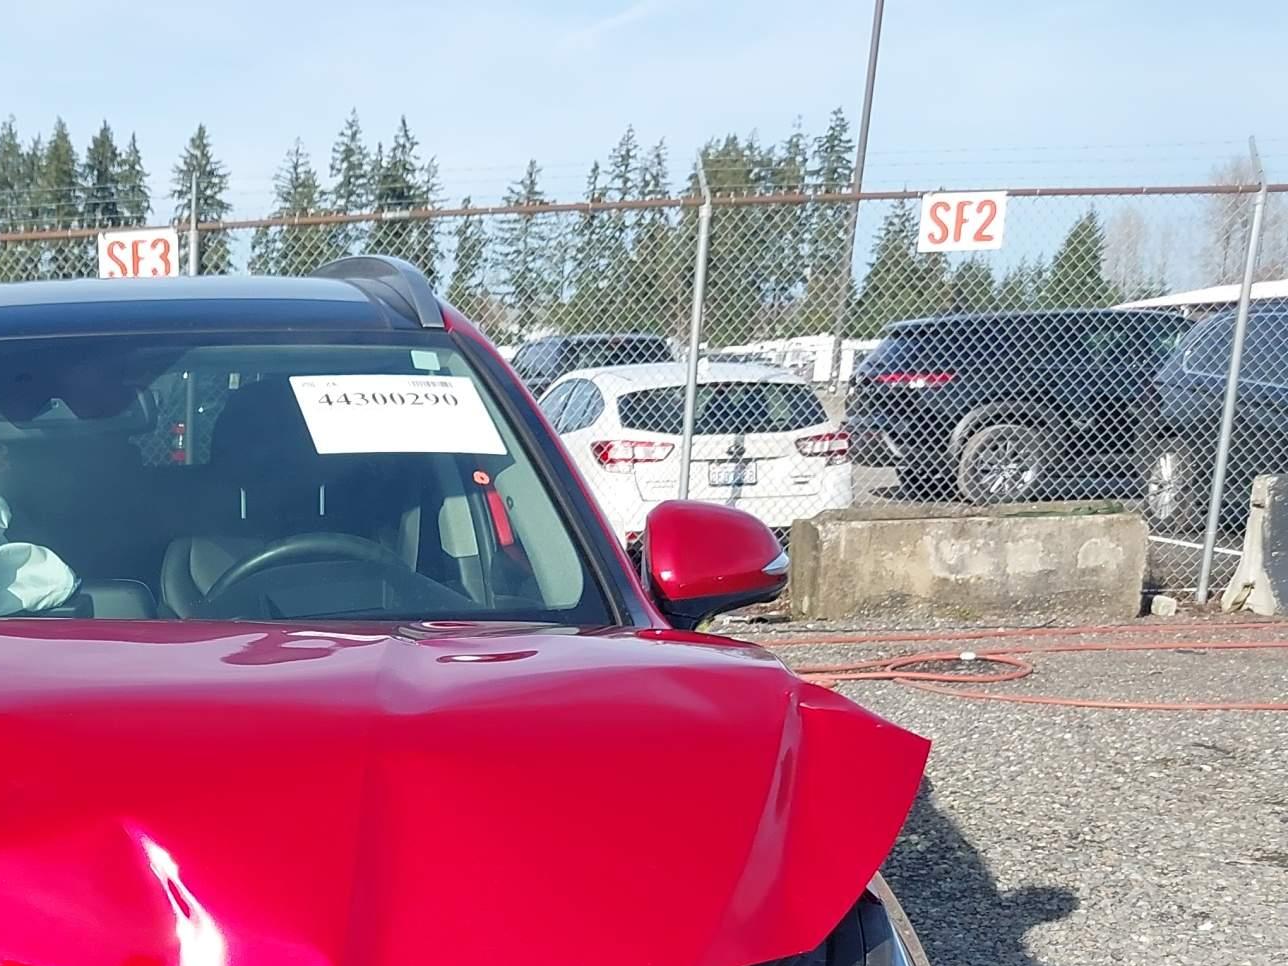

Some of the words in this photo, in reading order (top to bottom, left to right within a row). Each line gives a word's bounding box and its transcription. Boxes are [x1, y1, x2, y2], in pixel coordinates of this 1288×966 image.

[928, 199, 996, 244] SF2
[107, 238, 171, 277] SF3
[317, 391, 459, 407] 44300290
